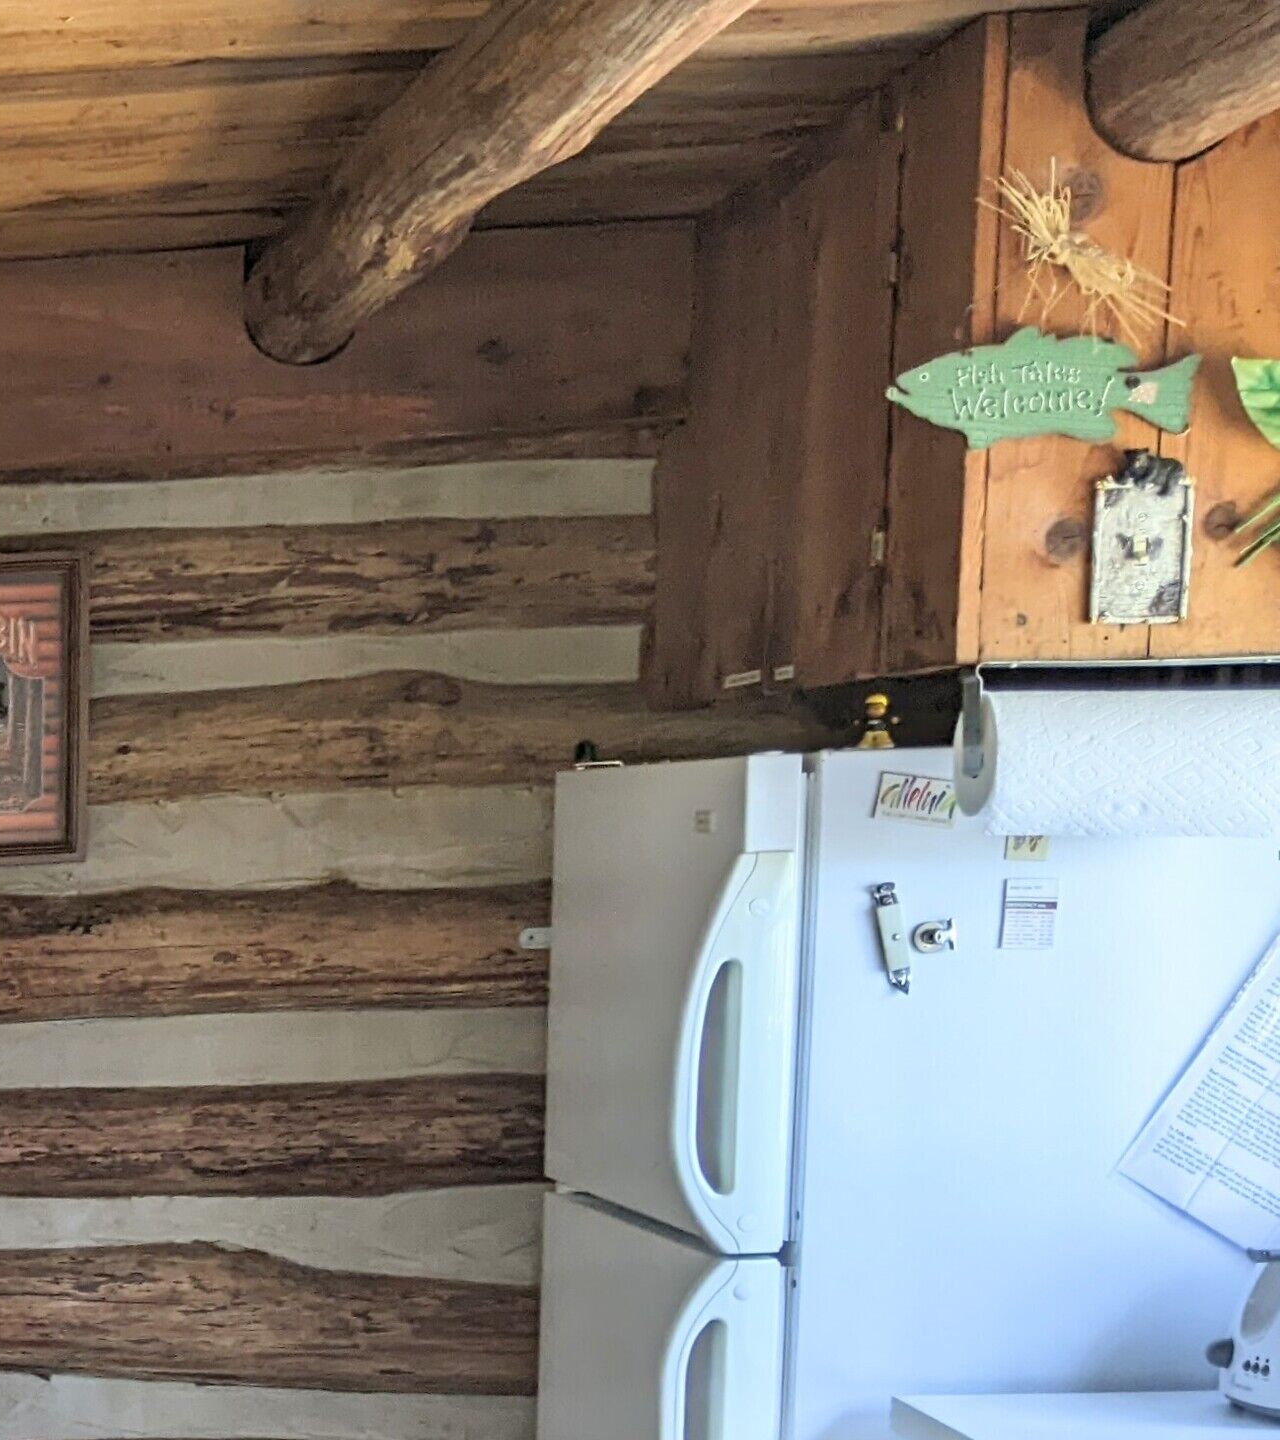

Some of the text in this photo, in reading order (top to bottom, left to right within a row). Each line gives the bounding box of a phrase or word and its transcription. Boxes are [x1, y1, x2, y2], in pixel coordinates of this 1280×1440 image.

[956, 360, 1081, 387] Fish Tales
[948, 376, 1115, 419] Welcome!
